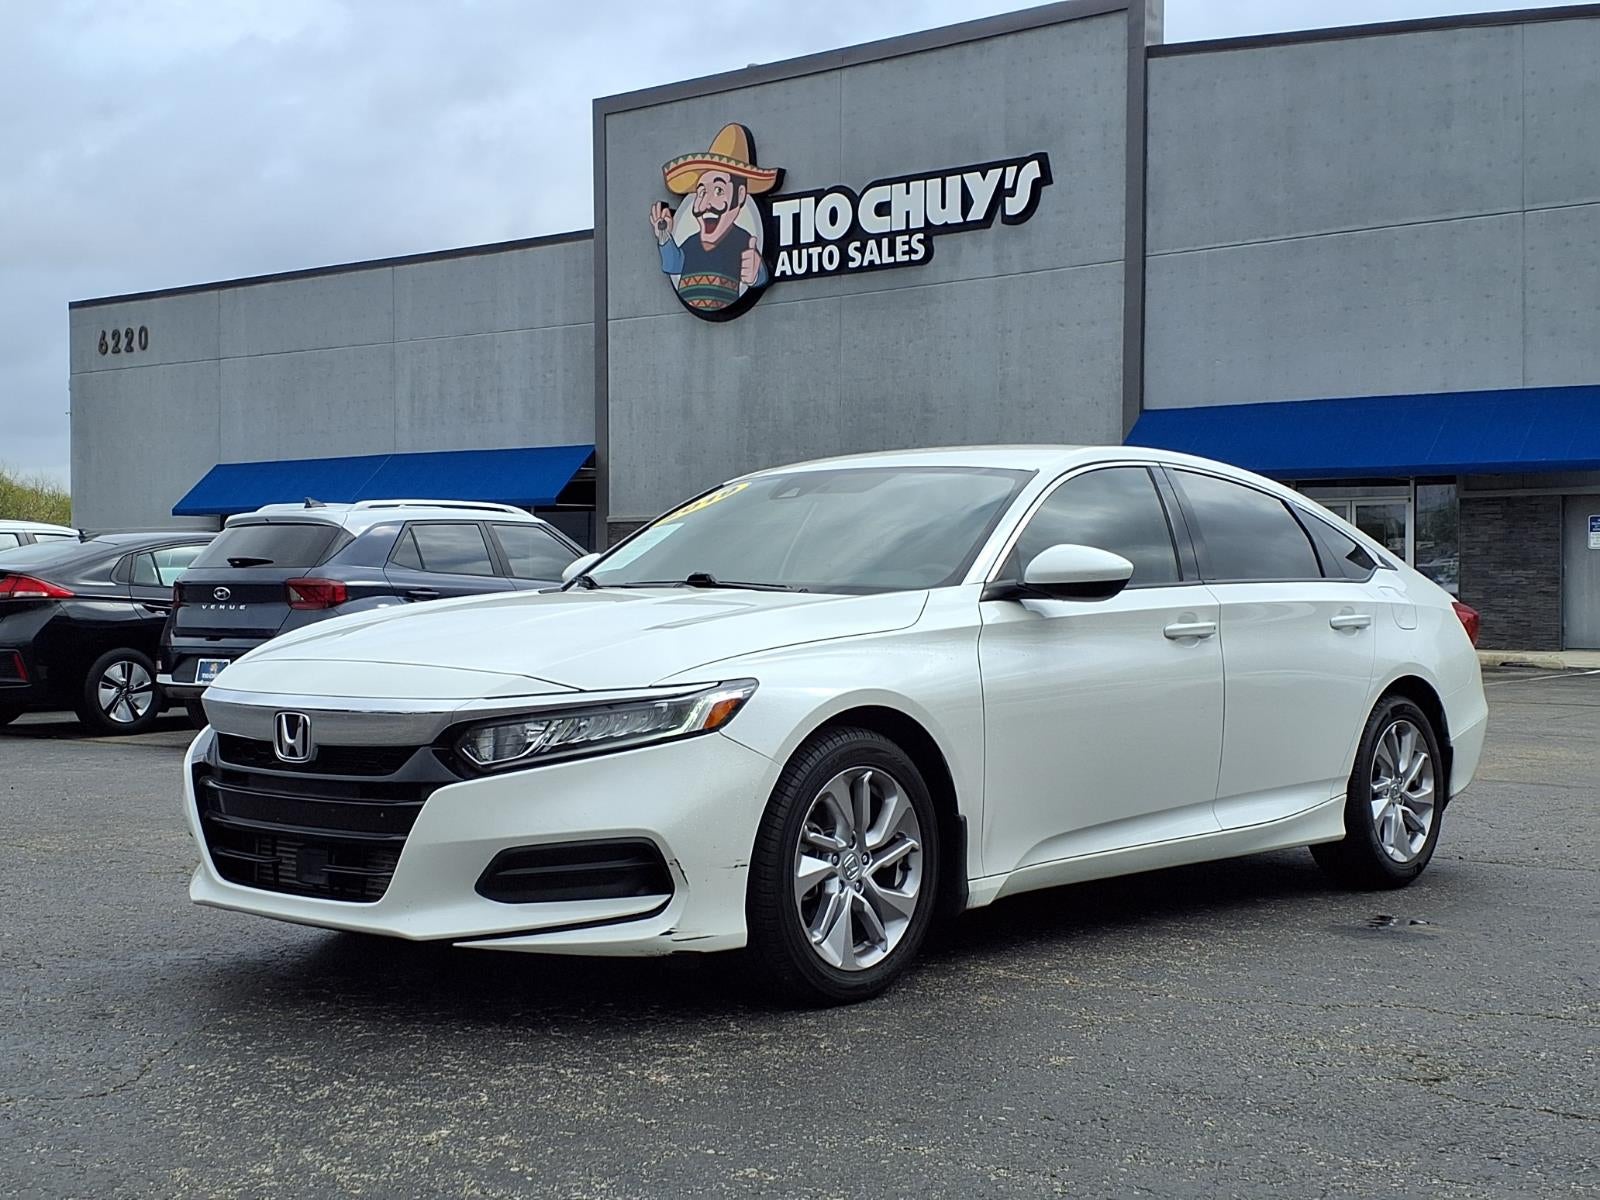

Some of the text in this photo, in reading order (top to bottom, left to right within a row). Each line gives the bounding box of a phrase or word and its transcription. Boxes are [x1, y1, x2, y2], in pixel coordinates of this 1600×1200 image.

[772, 160, 1042, 247] TIO CHUY'S
[774, 233, 926, 277] AUTO SALES
[98, 325, 149, 356] 6220
